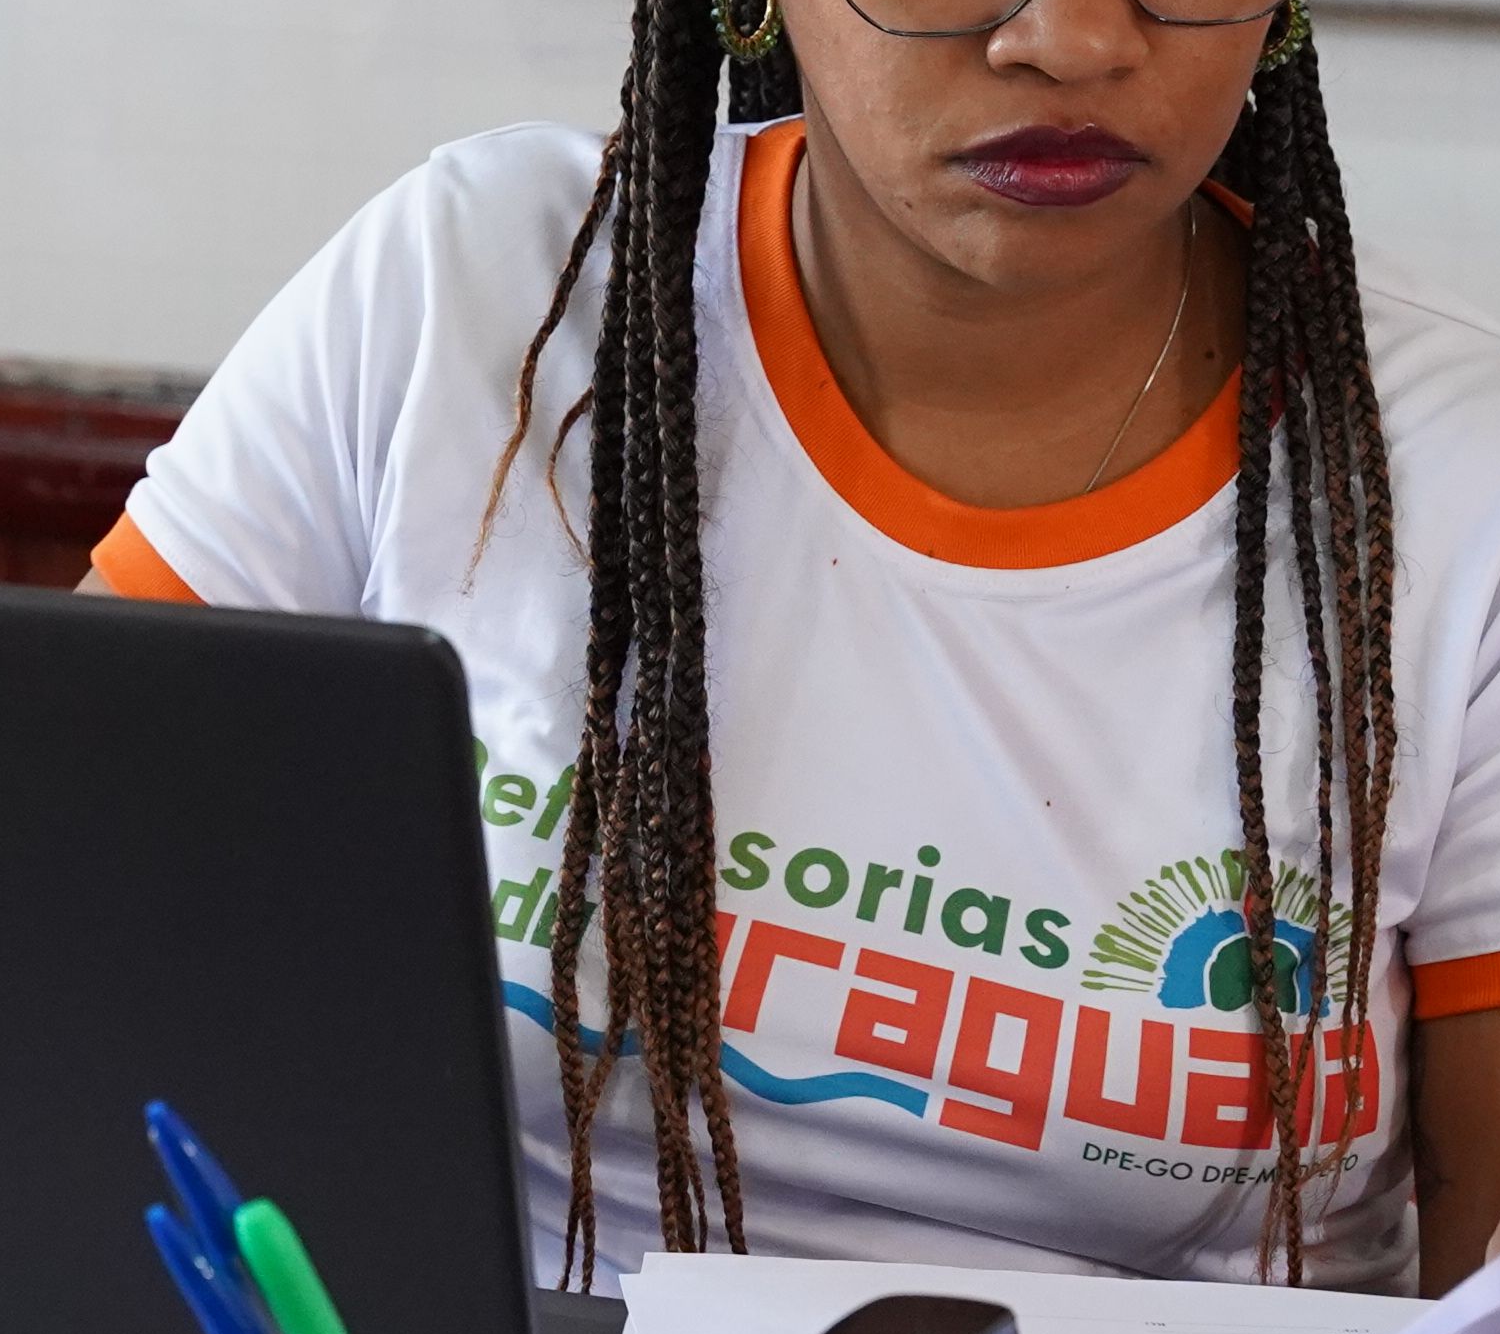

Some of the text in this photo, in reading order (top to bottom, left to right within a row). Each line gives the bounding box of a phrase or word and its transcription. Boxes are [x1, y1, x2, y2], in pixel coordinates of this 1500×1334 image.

[473, 736, 1072, 970] efsorias
[713, 910, 1380, 1152] raguaia
[1083, 1142, 1193, 1181] DPE-GO
[1202, 1165, 1280, 1185] DPE-M
